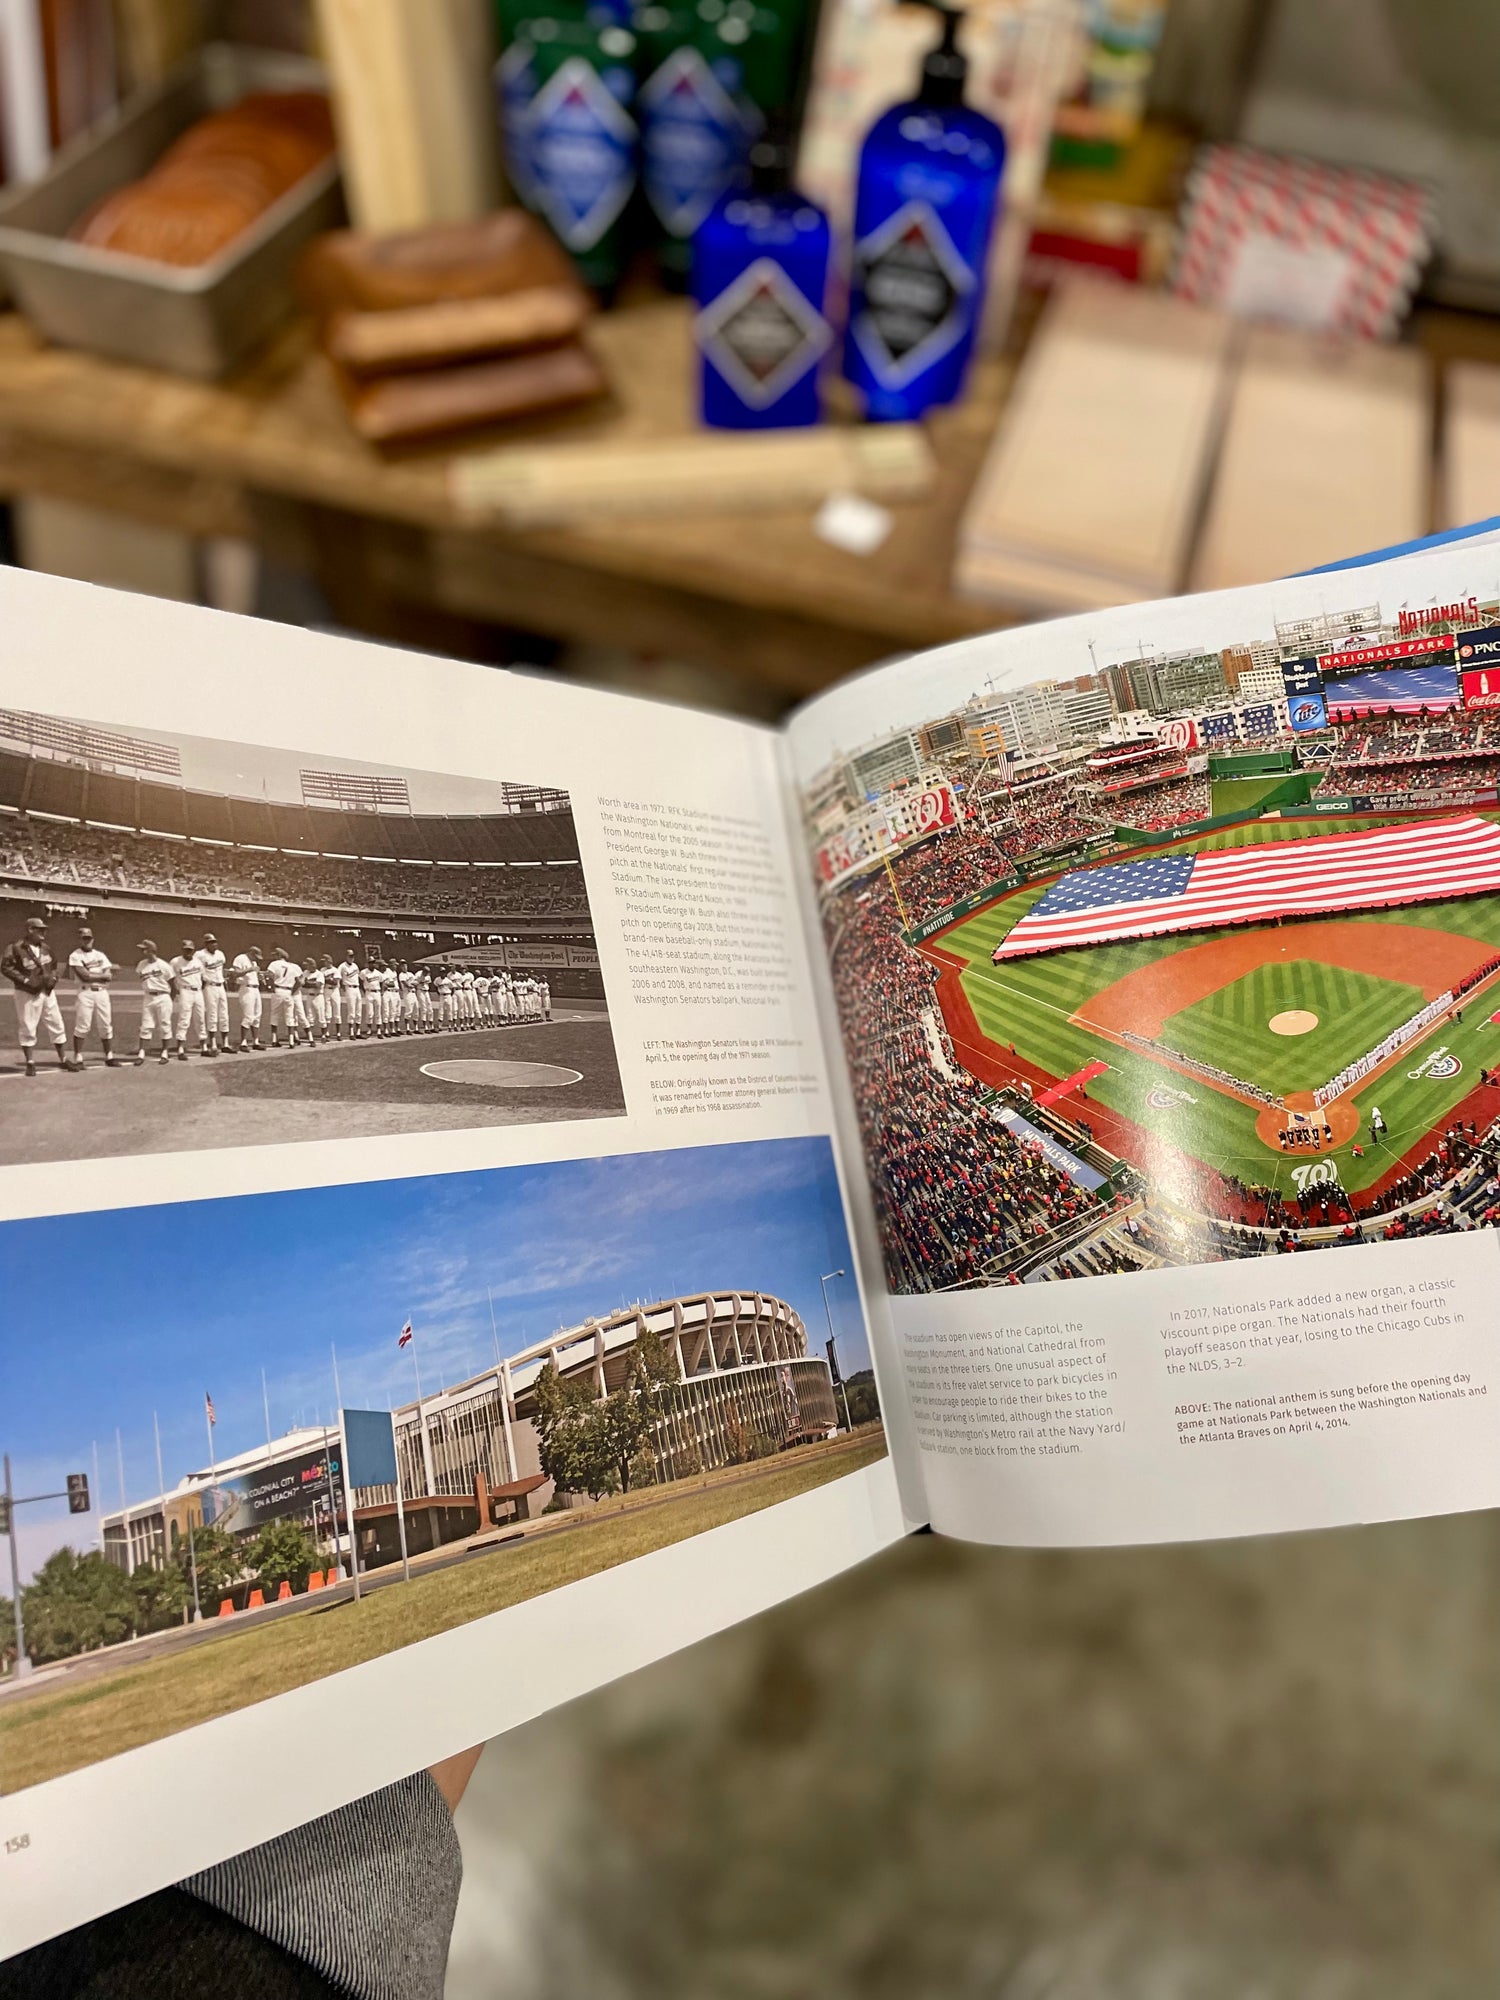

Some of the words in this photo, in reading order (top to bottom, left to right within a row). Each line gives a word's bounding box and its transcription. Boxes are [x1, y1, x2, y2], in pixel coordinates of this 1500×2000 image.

[1398, 597, 1478, 635] NATIONALS
[1324, 646, 1401, 666] NATIONALS
[1408, 639, 1446, 652] PARK
[1474, 641, 1500, 655] PNC
[1316, 802, 1348, 811] GEICO
[615, 813, 659, 827] Washington
[922, 911, 955, 936] #NATITUDE
[281, 966, 288, 978] 7
[629, 965, 678, 974] southeastern
[632, 979, 651, 989] 2006
[633, 995, 679, 1006] Washington
[680, 995, 711, 1004] Senators
[643, 1040, 661, 1050] LEFT:
[661, 1040, 674, 1049] The
[675, 1040, 712, 1050] Washington
[712, 1039, 739, 1048] Senators
[645, 1053, 662, 1065] April
[670, 1053, 681, 1062] the
[682, 1052, 708, 1063] opening
[708, 1051, 720, 1062] day
[650, 1080, 677, 1089] BELOW:
[677, 1078, 708, 1089] Originally
[708, 1077, 728, 1086] known
[659, 1094, 673, 1102] was
[673, 1091, 702, 1101] renamed
[703, 1090, 712, 1099] for
[655, 1106, 663, 1116] in
[663, 1106, 679, 1115] 1969
[680, 1104, 695, 1114] after
[696, 1104, 706, 1112] his
[707, 1103, 721, 1112] 1968
[1058, 1155, 1081, 1174] PARK
[1170, 1311, 1181, 1321] In
[1184, 1307, 1211, 1320] 2017,
[1213, 1301, 1267, 1316] Nationals
[1269, 1297, 1294, 1310] Park
[1297, 1293, 1332, 1307] added
[1335, 1293, 1342, 1302] a
[1345, 1289, 1368, 1301] new
[1370, 1285, 1406, 1299] organ,
[1408, 1284, 1416, 1293] a
[1418, 1278, 1457, 1292] classic
[1160, 1326, 1210, 1340] Viscount
[1212, 1324, 1237, 1336] pipe
[1240, 1319, 1276, 1332] organ.
[1278, 1315, 1299, 1327] The
[1301, 1307, 1355, 1324] Nationals
[1357, 1304, 1379, 1317] had
[1382, 1301, 1409, 1313] their
[1410, 1296, 1447, 1311] fourth
[969, 1330, 992, 1341] views
[994, 1328, 1005, 1339] of
[1006, 1327, 1022, 1338] the
[1025, 1323, 1063, 1337] Capitol,
[1065, 1322, 1084, 1332] the
[1164, 1342, 1204, 1359] playoff
[1206, 1339, 1247, 1353] season
[1249, 1335, 1273, 1348] that
[1275, 1334, 1302, 1347] year,
[1304, 1328, 1339, 1342] losing
[1341, 1326, 1353, 1337] to
[1355, 1323, 1374, 1336] the
[1377, 1317, 1421, 1333] Chicago
[1423, 1314, 1451, 1327] Cubs
[1454, 1312, 1465, 1323] in
[987, 1344, 1025, 1356] National
[1027, 1339, 1077, 1353] Cathedral
[1080, 1337, 1106, 1348] from
[994, 1362, 1013, 1372] One
[1016, 1358, 1055, 1371] unusual
[1057, 1355, 1092, 1368] aspect
[1096, 1352, 1107, 1363] of
[1167, 1362, 1186, 1375] the
[1189, 1359, 1222, 1372] NLDS,
[990, 1378, 1021, 1389] service
[1037, 1374, 1060, 1388] park
[1062, 1371, 1105, 1385] bicycles
[1107, 1369, 1118, 1380] in
[1000, 1395, 1018, 1406] ride
[1020, 1394, 1043, 1405] their
[1046, 1392, 1073, 1403] bikes
[1075, 1391, 1087, 1401] to
[1089, 1388, 1108, 1399] the
[1174, 1402, 1212, 1415] ABOVE:
[1214, 1401, 1232, 1411] The
[1235, 1395, 1276, 1409] national
[1279, 1391, 1317, 1404] anthem
[1319, 1388, 1329, 1399] is
[1330, 1386, 1355, 1399] sung
[1356, 1382, 1390, 1395] before
[1391, 1379, 1408, 1391] the
[1410, 1375, 1452, 1390] opening
[1453, 1371, 1471, 1384] day
[976, 1411, 1008, 1423] limited,
[1010, 1410, 1053, 1422] although
[1055, 1409, 1072, 1420] the
[1075, 1405, 1113, 1418] station
[1177, 1418, 1205, 1432] game
[1207, 1416, 1217, 1427] at
[1219, 1411, 1268, 1426] Nationals
[1270, 1407, 1293, 1419] Park
[1294, 1403, 1338, 1418] between
[1339, 1401, 1357, 1412] the
[1358, 1395, 1417, 1410] Washington
[1419, 1389, 1466, 1403] Nationals
[1468, 1385, 1488, 1396] and
[991, 1429, 1016, 1439] Metro
[1019, 1427, 1034, 1438] rail
[1049, 1426, 1066, 1437] the
[1068, 1424, 1095, 1437] Navy
[1179, 1434, 1197, 1445] the
[1199, 1430, 1235, 1443] Atlanta
[1237, 1426, 1271, 1439] Braves
[1273, 1425, 1286, 1435] on
[1289, 1421, 1313, 1435] April
[1314, 1421, 1324, 1431] 4,
[1326, 1417, 1351, 1429] 2014.
[974, 1445, 995, 1456] block
[997, 1445, 1018, 1455] from
[1020, 1444, 1036, 1455] the
[1039, 1443, 1083, 1455] stadium.
[248, 1481, 280, 1498] COLONIAL
[281, 1475, 295, 1487] CITY
[254, 1499, 265, 1509] ON
[3, 1832, 31, 1855] 158
